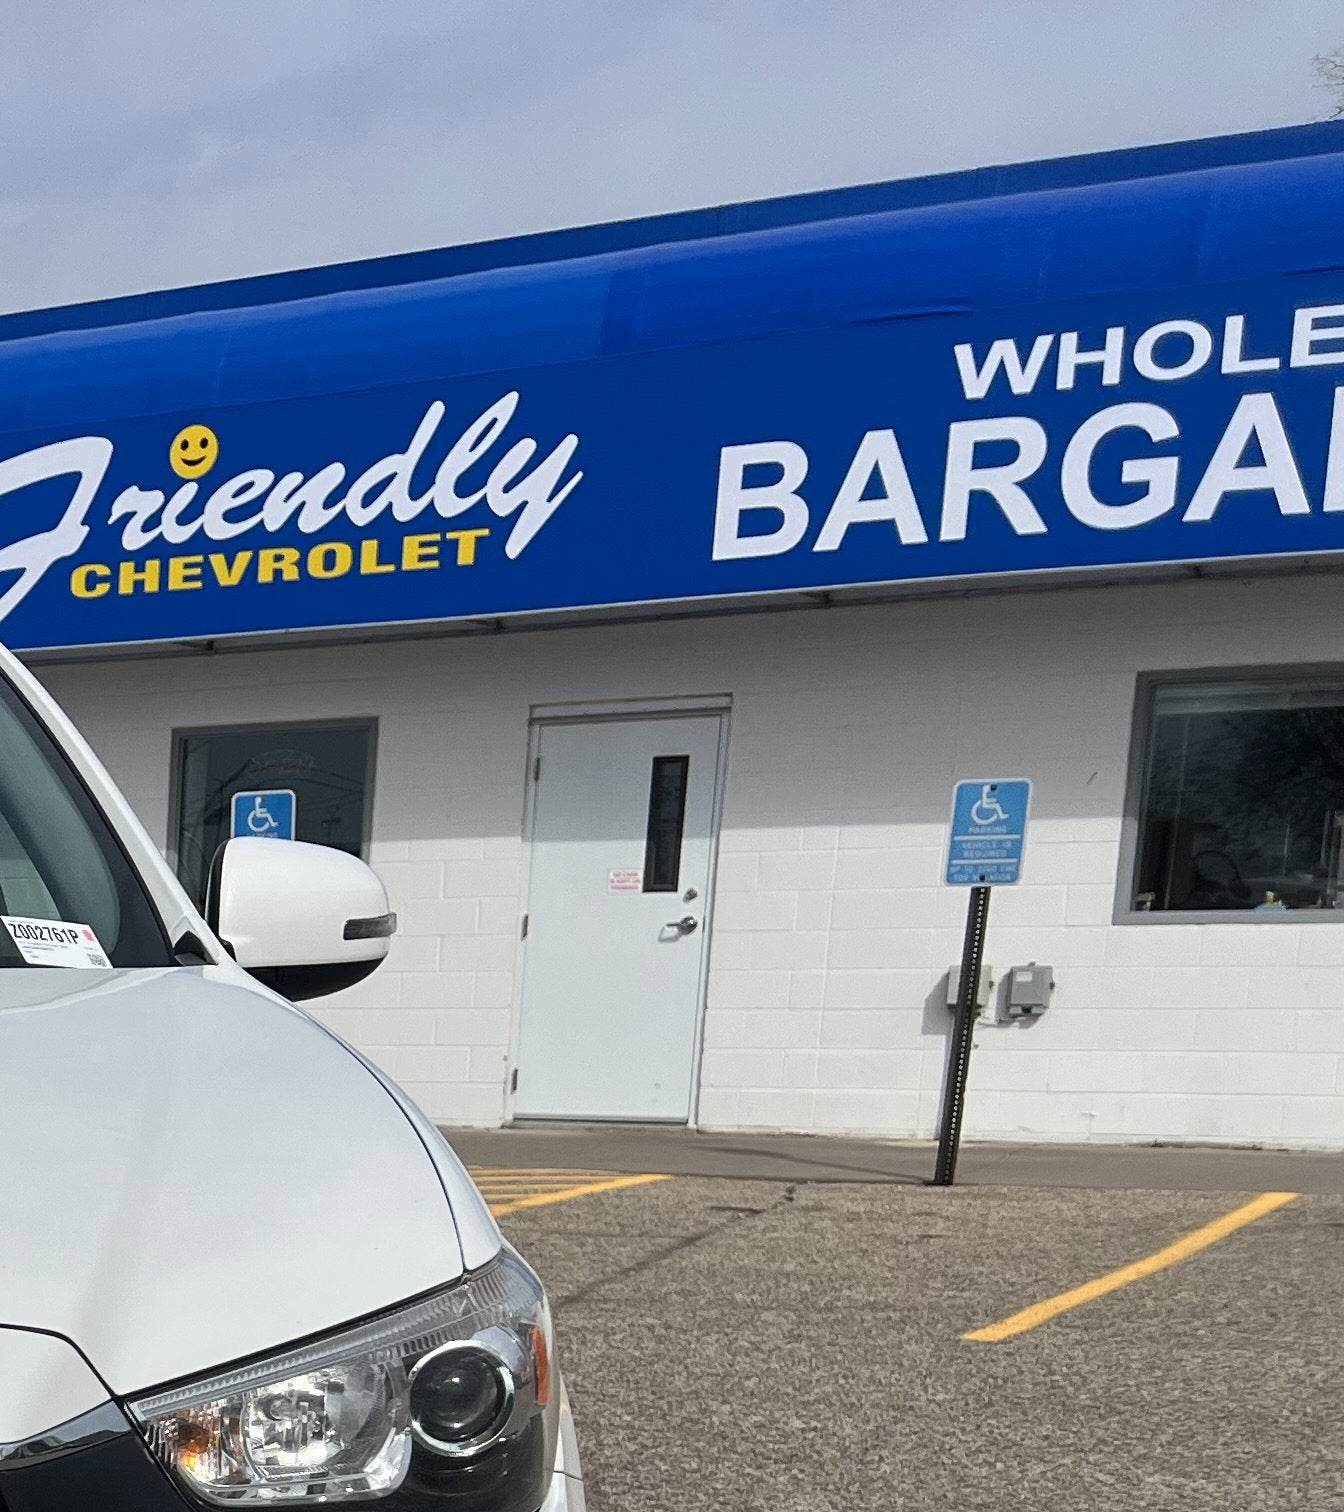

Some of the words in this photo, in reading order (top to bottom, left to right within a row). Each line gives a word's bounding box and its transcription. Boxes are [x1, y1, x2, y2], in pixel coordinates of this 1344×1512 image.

[953, 304, 1344, 399] WHOLE
[70, 528, 490, 598] CHEVROLET
[8, 923, 79, 944] Z002761P
